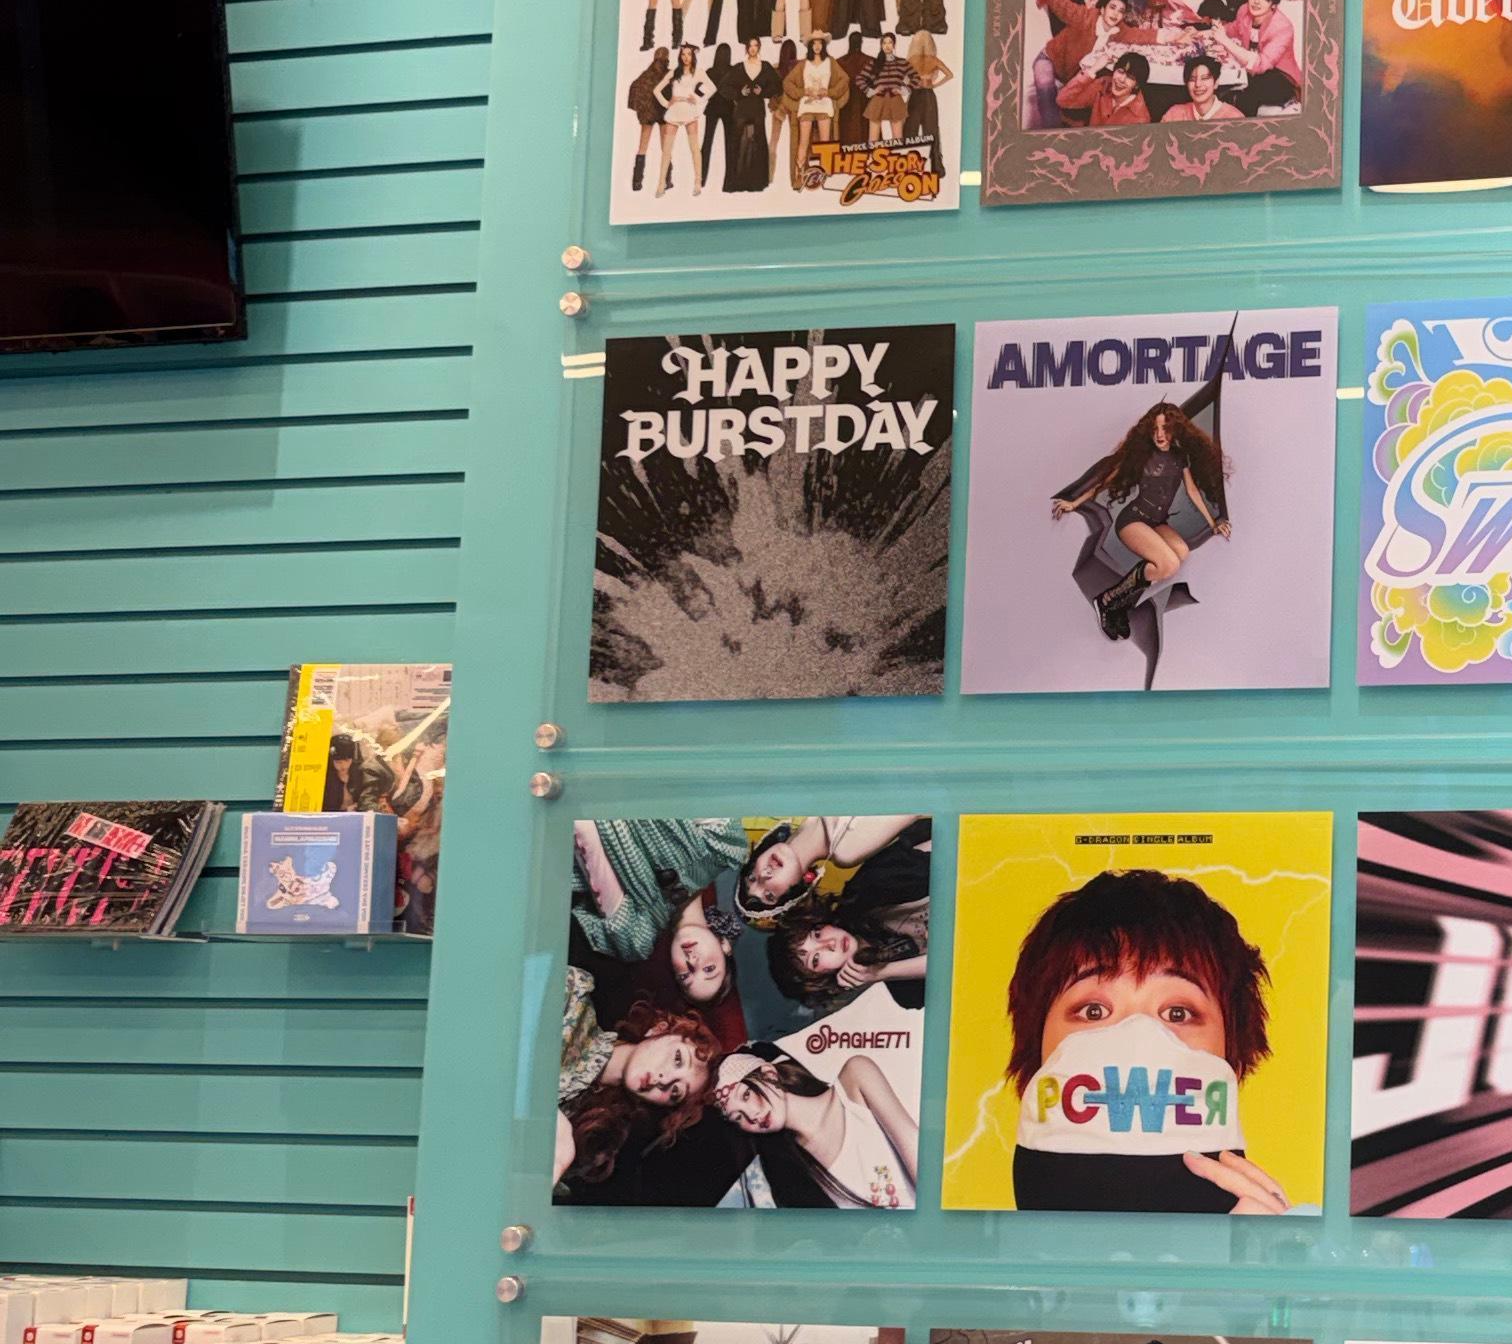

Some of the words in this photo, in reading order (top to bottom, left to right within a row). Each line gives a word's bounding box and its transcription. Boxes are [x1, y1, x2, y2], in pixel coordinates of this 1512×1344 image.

[811, 143, 868, 176] THE
[868, 147, 928, 174] STORY
[842, 142, 867, 153] TWICE
[869, 139, 903, 150] SPECIAL
[905, 134, 935, 146] ALBUM
[897, 171, 940, 203] ON
[661, 341, 891, 405] HAPPY
[987, 329, 1323, 391] AMORTAGE
[614, 399, 939, 464] BURSTDAY
[1133, 834, 1175, 844] SINGLE
[1177, 834, 1213, 844] ALBUM
[806, 1024, 911, 1054] SPAGHETTI
